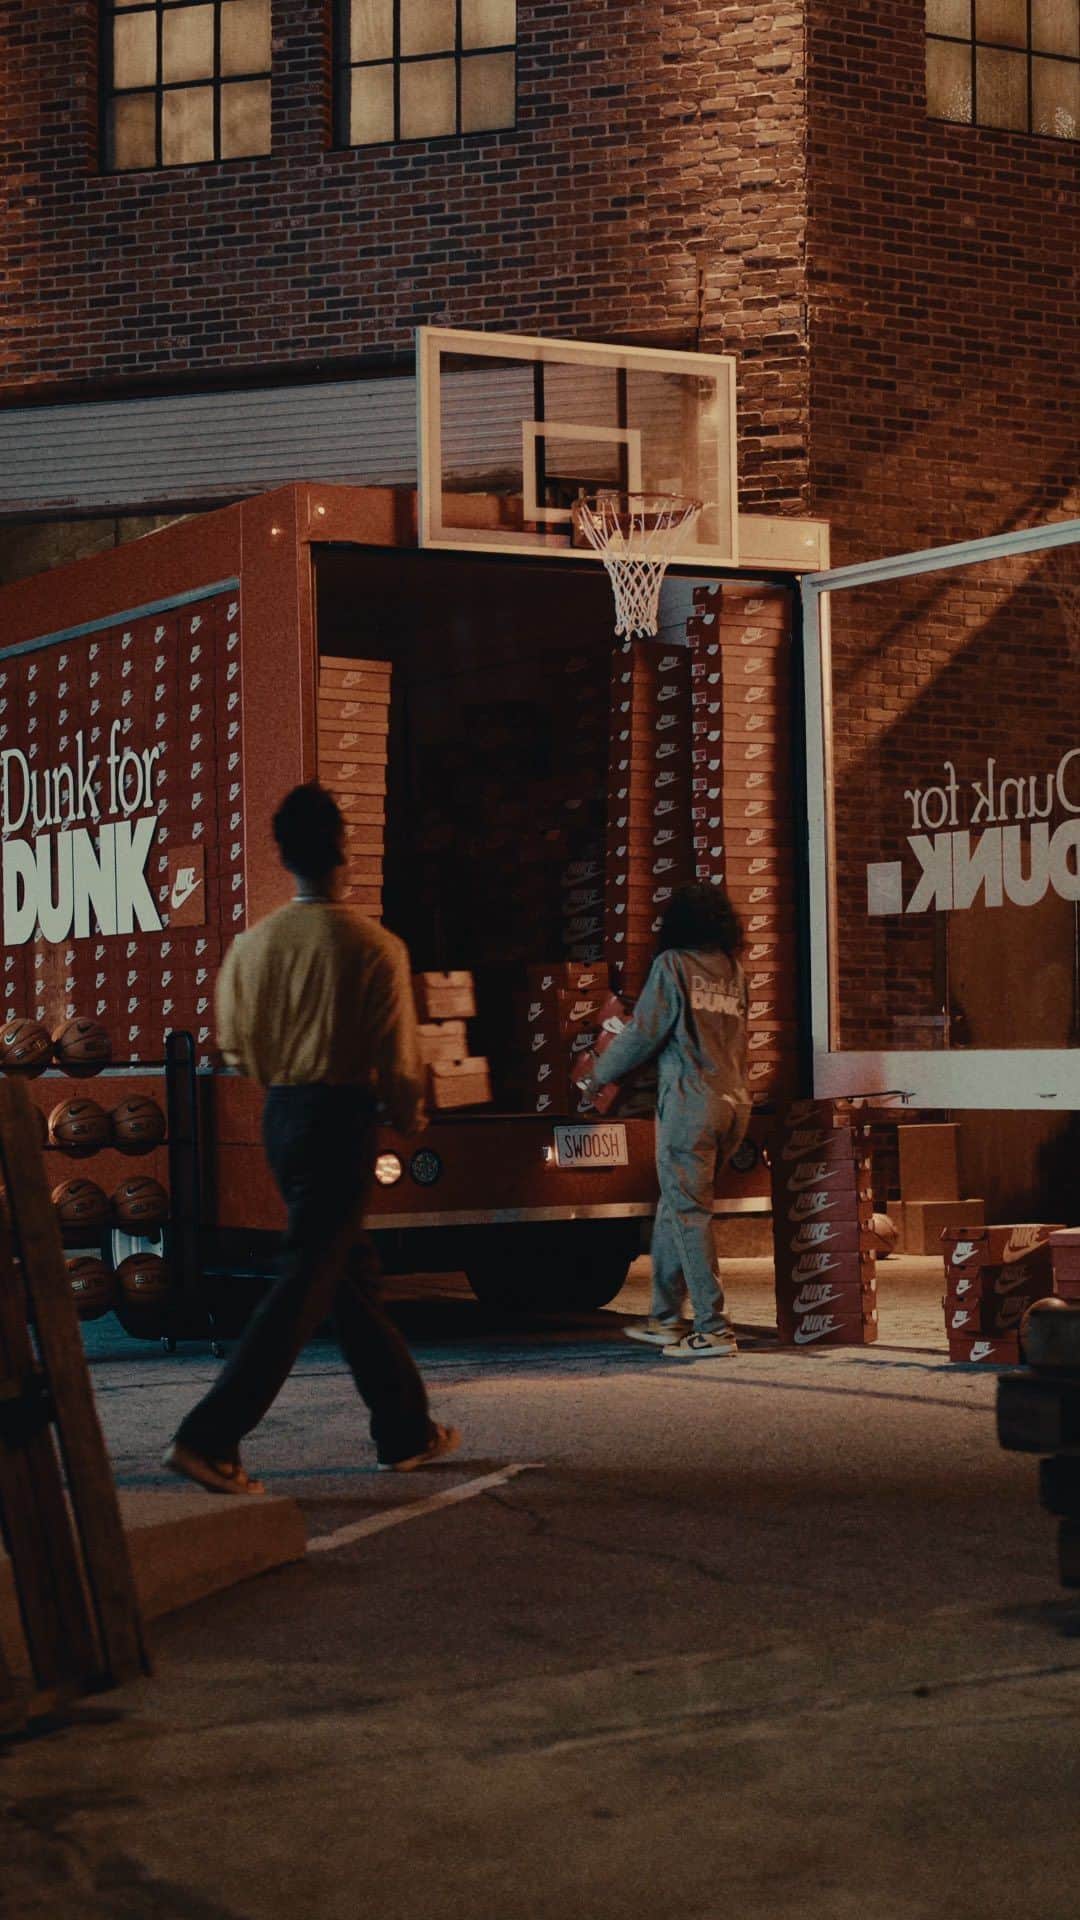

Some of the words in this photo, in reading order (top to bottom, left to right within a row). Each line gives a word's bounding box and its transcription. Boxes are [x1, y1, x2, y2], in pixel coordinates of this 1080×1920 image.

[1, 730, 100, 833] Dunk
[107, 719, 160, 815] for
[3, 815, 164, 946] DUNK
[564, 1134, 620, 1159] SWOOSH
[796, 1192, 829, 1209] NIKE
[799, 1222, 831, 1240] NIKE
[1010, 1228, 1042, 1248] NIKE
[799, 1253, 832, 1270] NIKE
[800, 1284, 833, 1302] NIKE
[801, 1314, 835, 1332] NIKE
